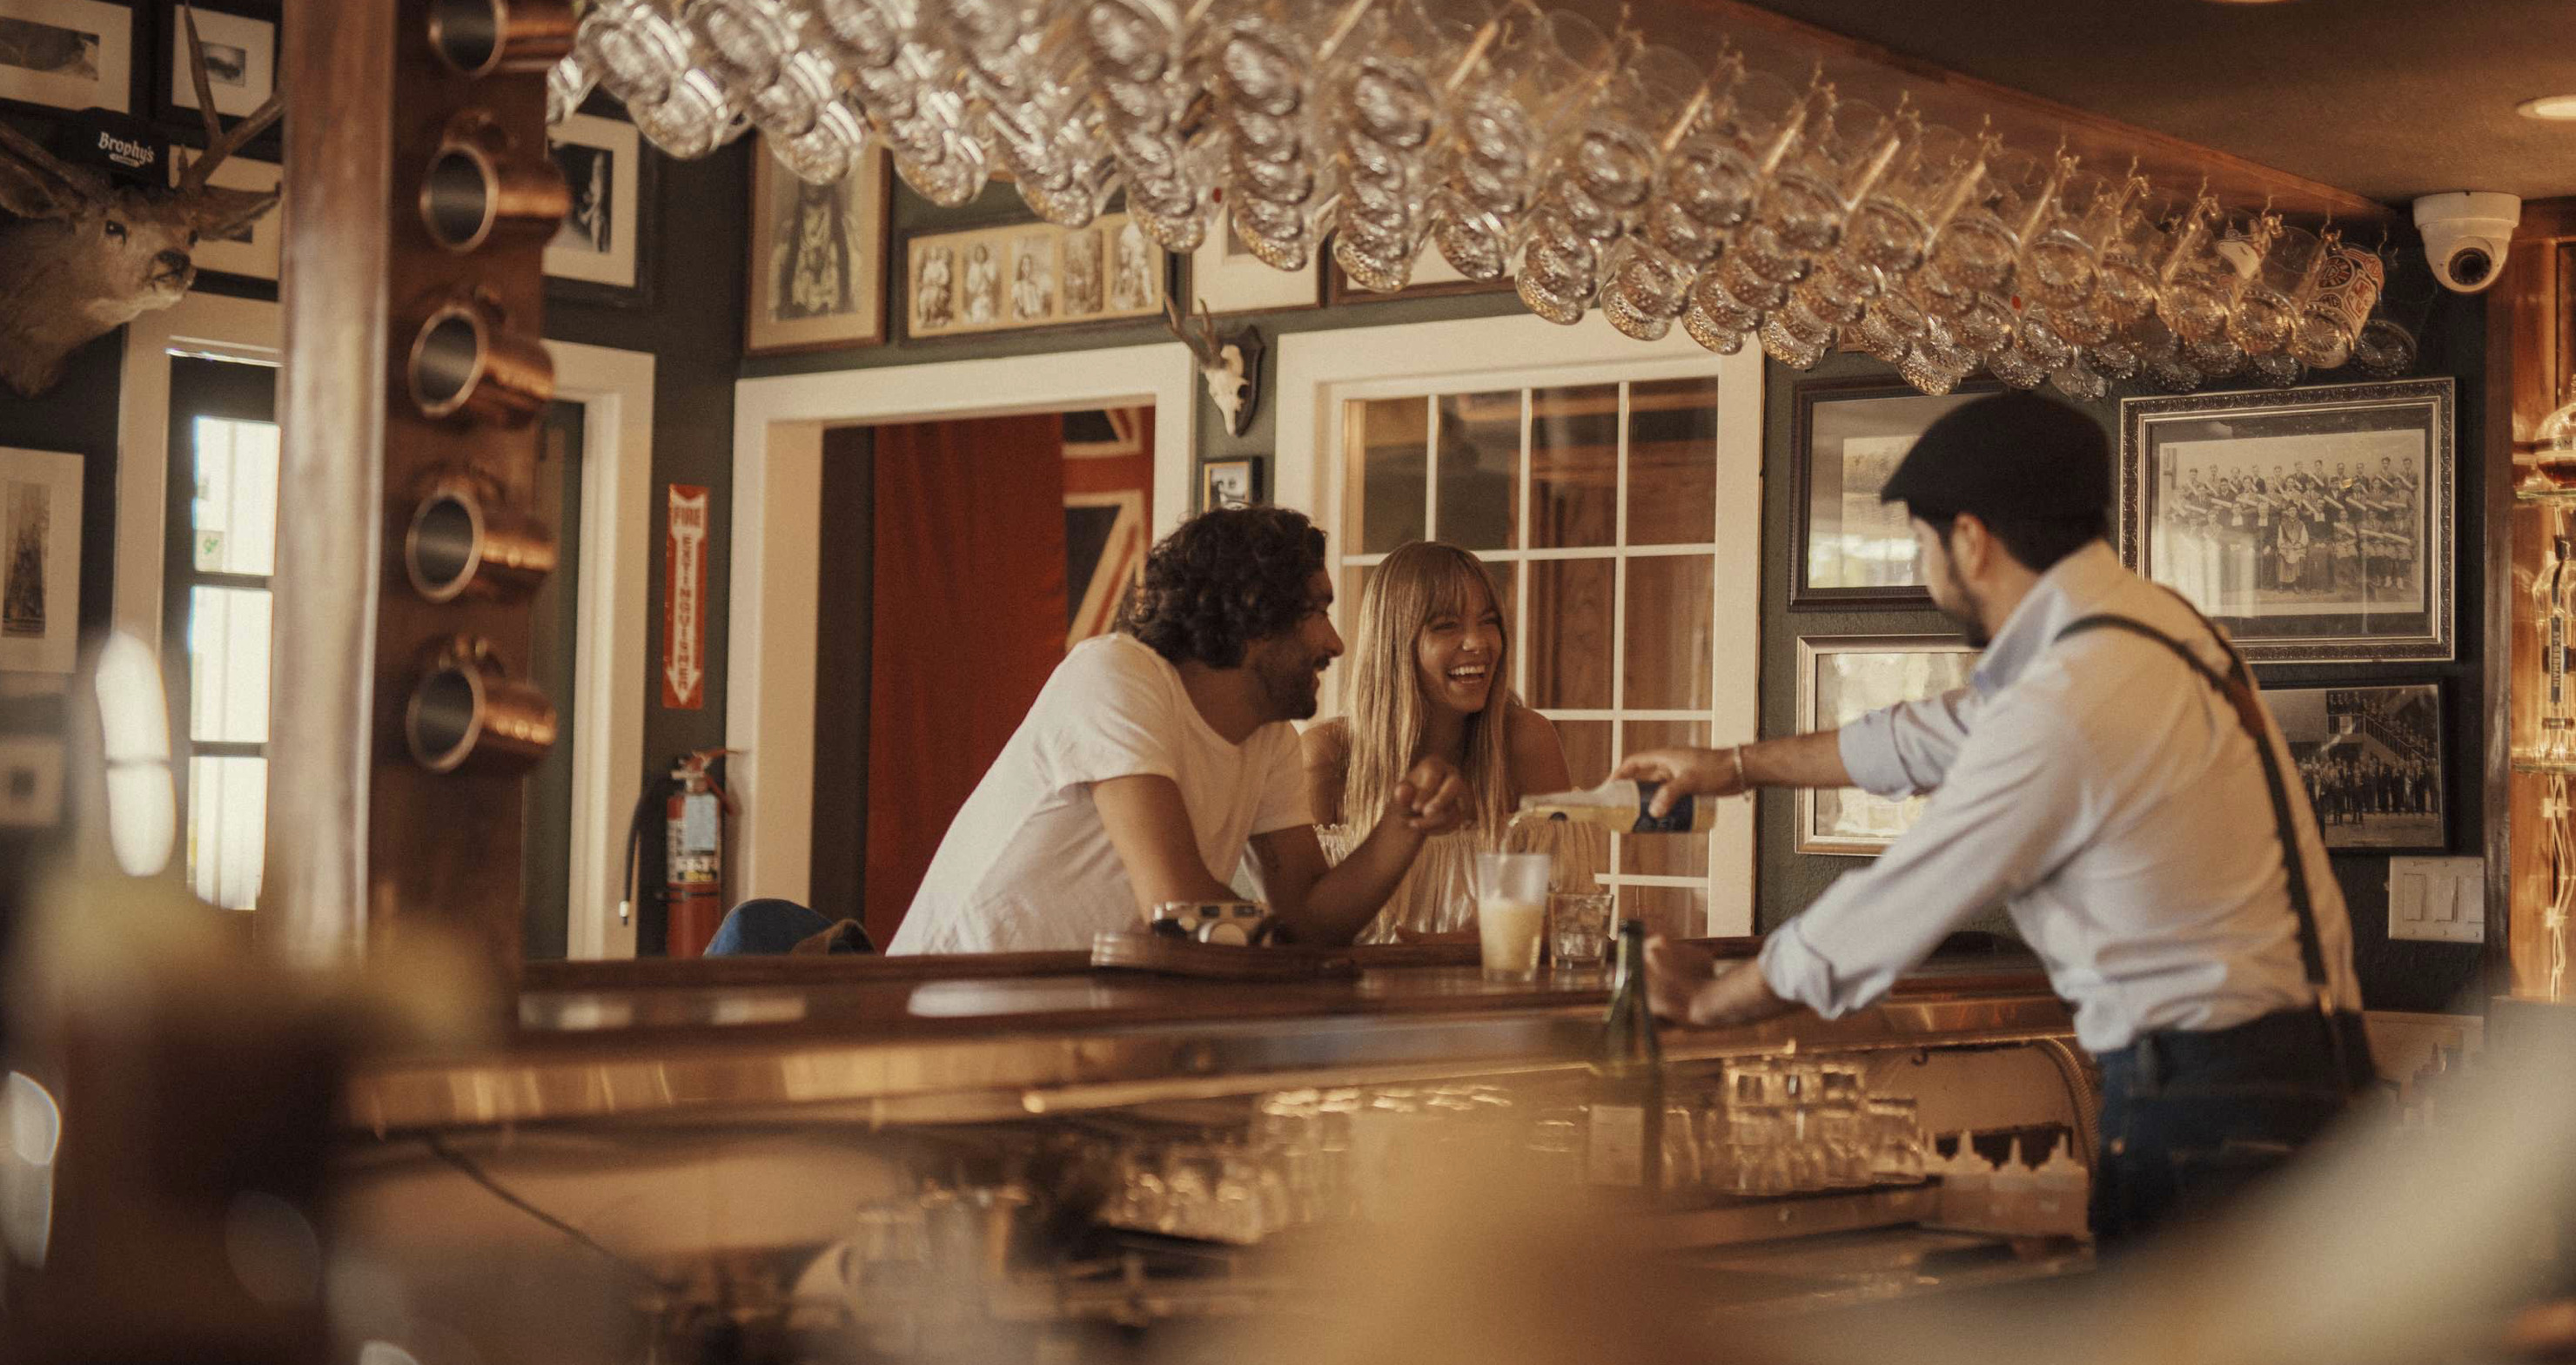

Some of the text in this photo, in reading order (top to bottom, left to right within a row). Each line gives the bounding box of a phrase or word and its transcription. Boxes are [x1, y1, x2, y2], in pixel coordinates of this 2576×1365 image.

[98, 131, 155, 165] Brophy's
[673, 507, 701, 528] FIRE
[679, 535, 693, 690] EXTINGUISHER
